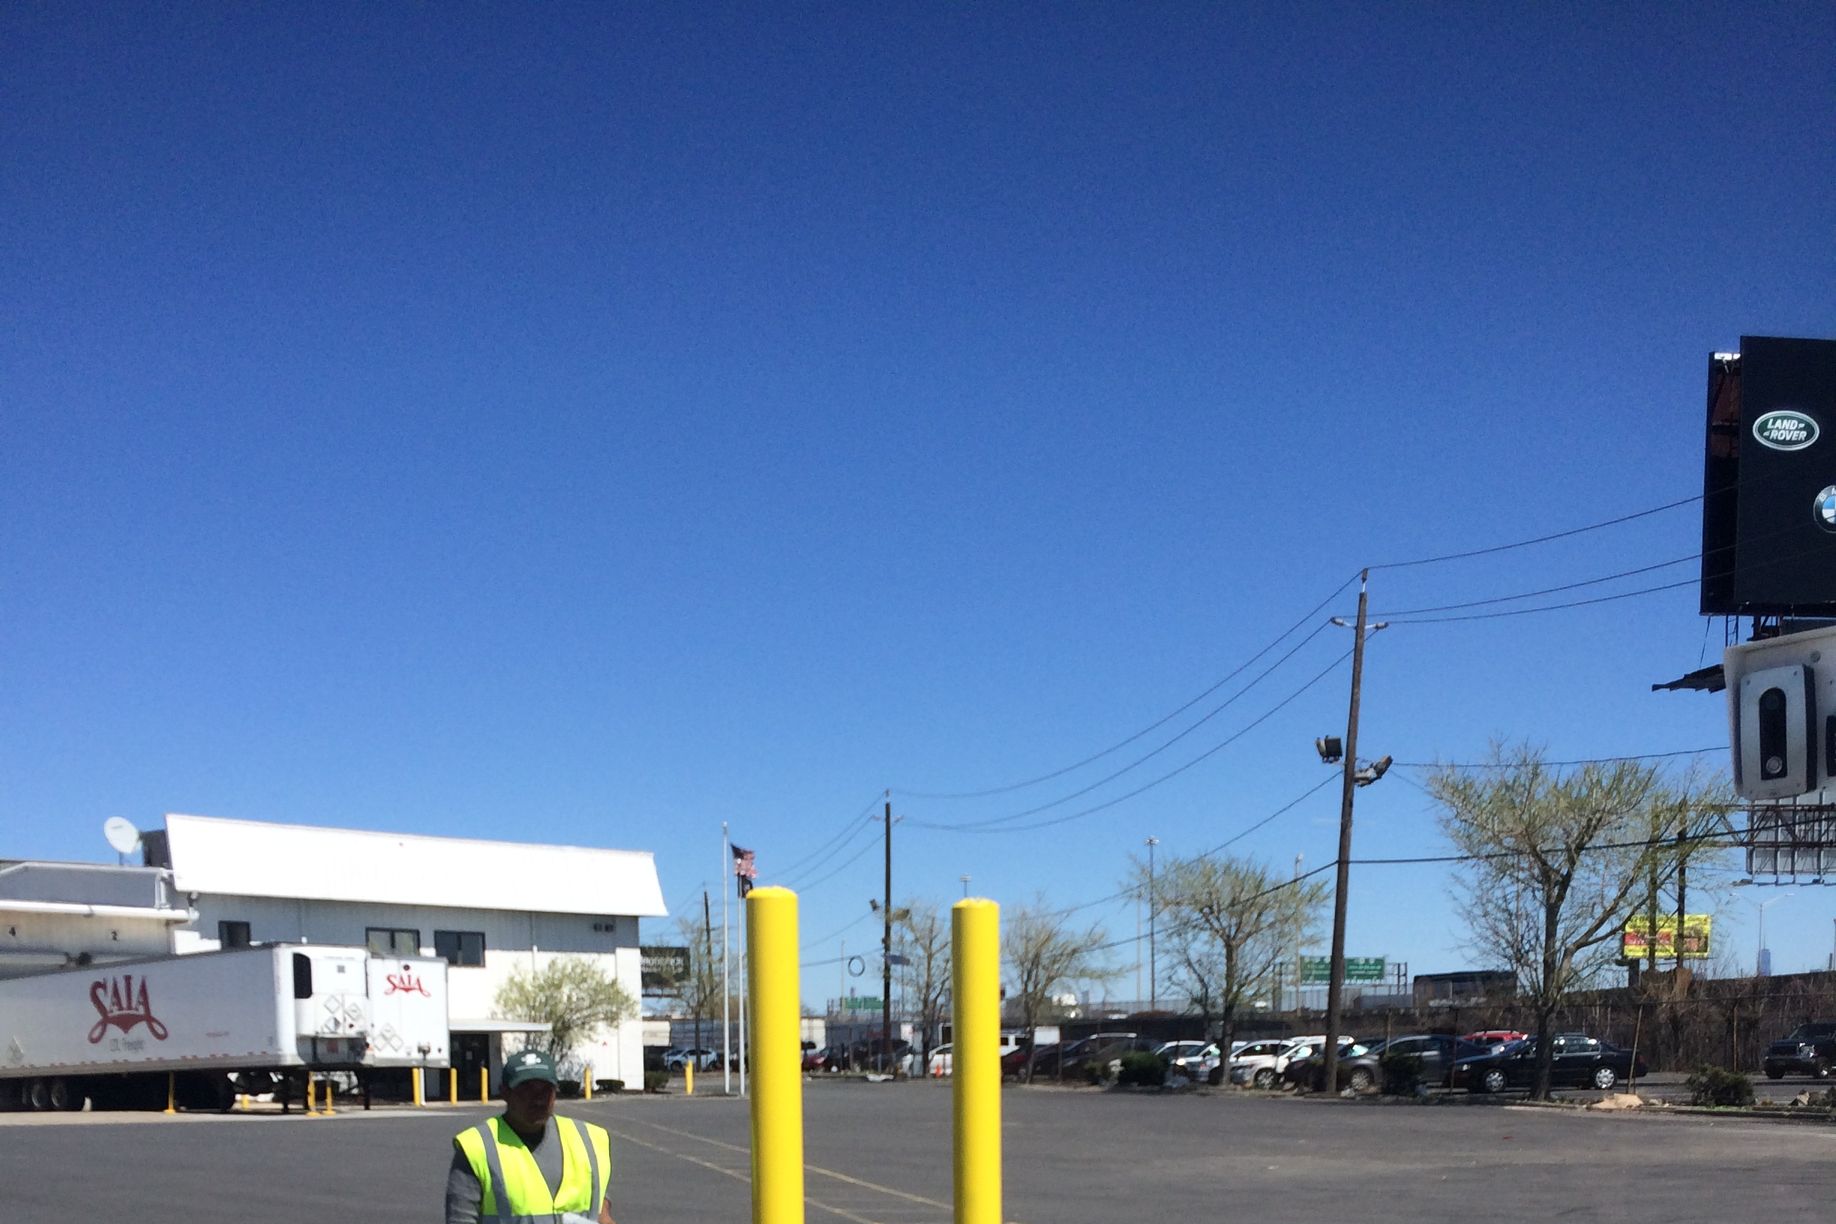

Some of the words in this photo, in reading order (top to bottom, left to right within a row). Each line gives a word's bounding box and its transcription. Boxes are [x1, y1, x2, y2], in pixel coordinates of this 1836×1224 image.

[1767, 419, 1798, 430] LAND
[1769, 430, 1807, 441] ROVER
[384, 974, 431, 997] SAIA
[88, 974, 168, 1043] SAIA
